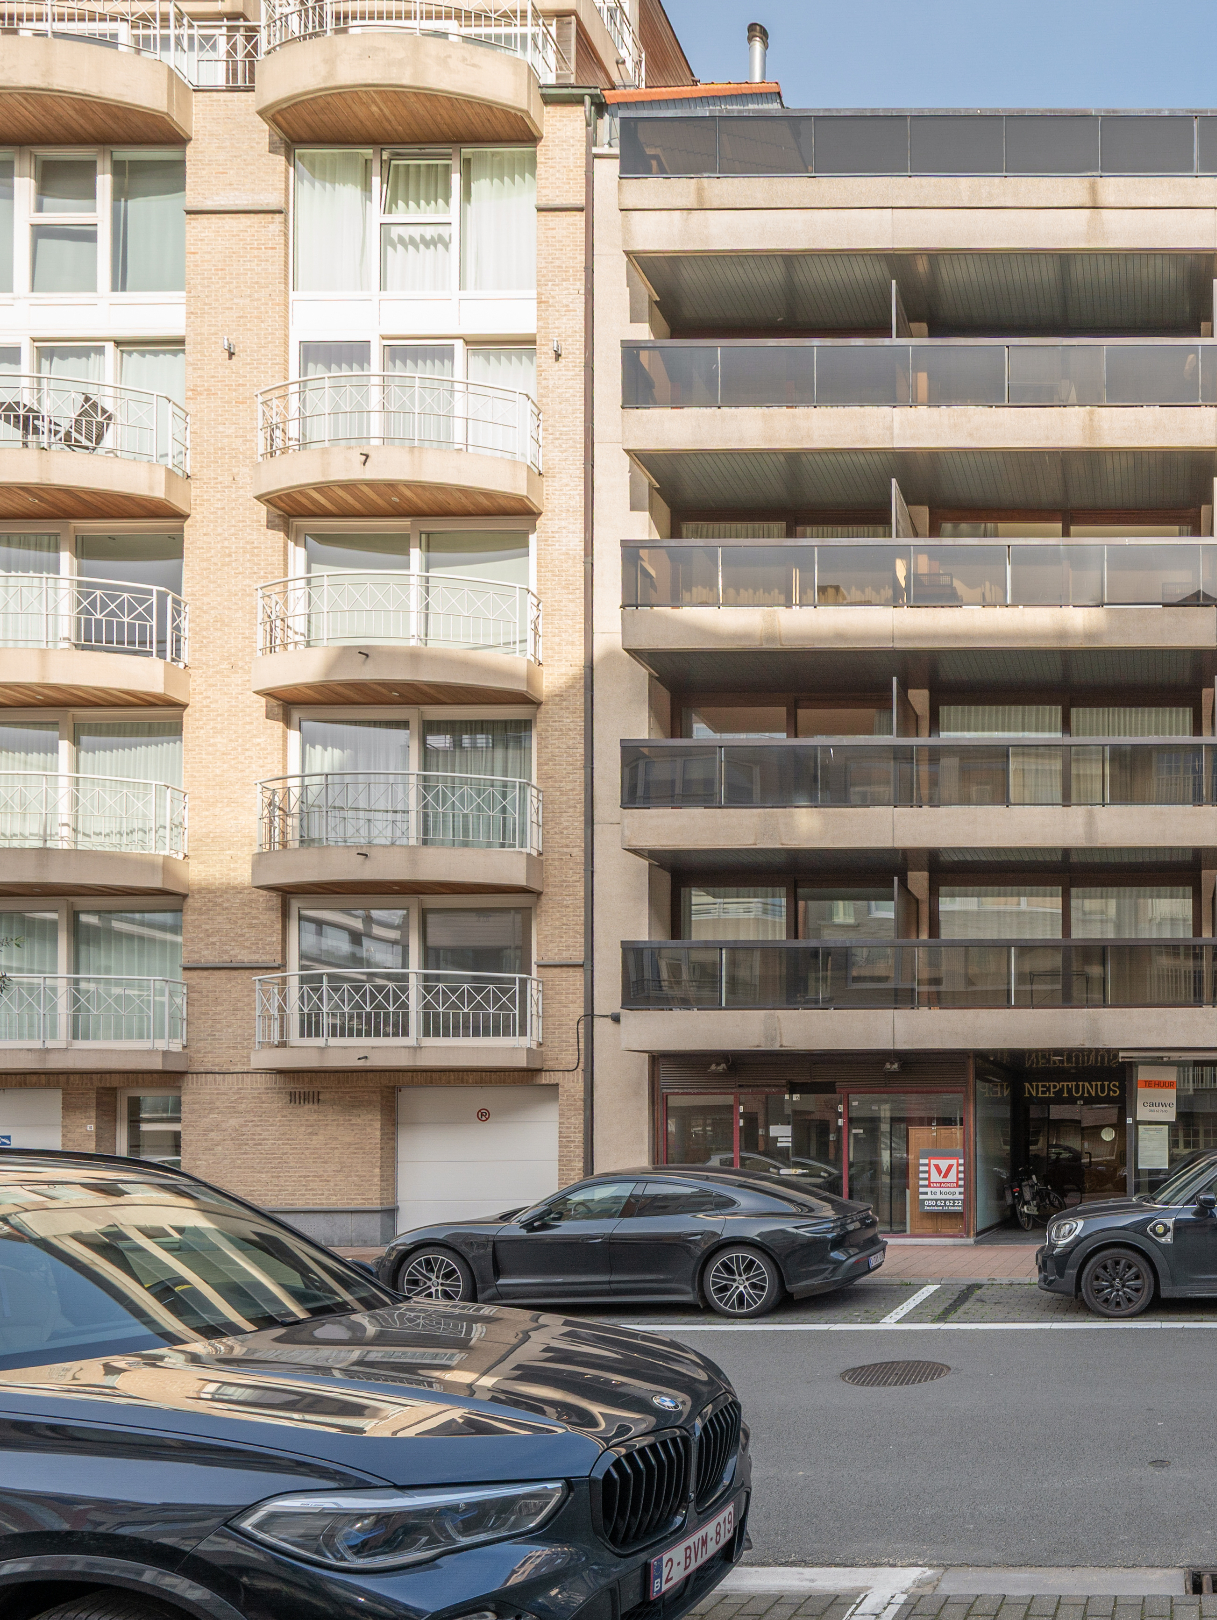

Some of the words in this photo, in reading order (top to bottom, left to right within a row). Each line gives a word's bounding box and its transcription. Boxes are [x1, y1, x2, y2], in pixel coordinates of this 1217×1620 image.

[1023, 1081, 1120, 1097] NEPTUNUS
[1154, 1081, 1175, 1089] HUUR
[1142, 1101, 1175, 1109] cauwe
[653, 1578, 661, 1592] B
[663, 1510, 733, 1586] 2-BVM-819
